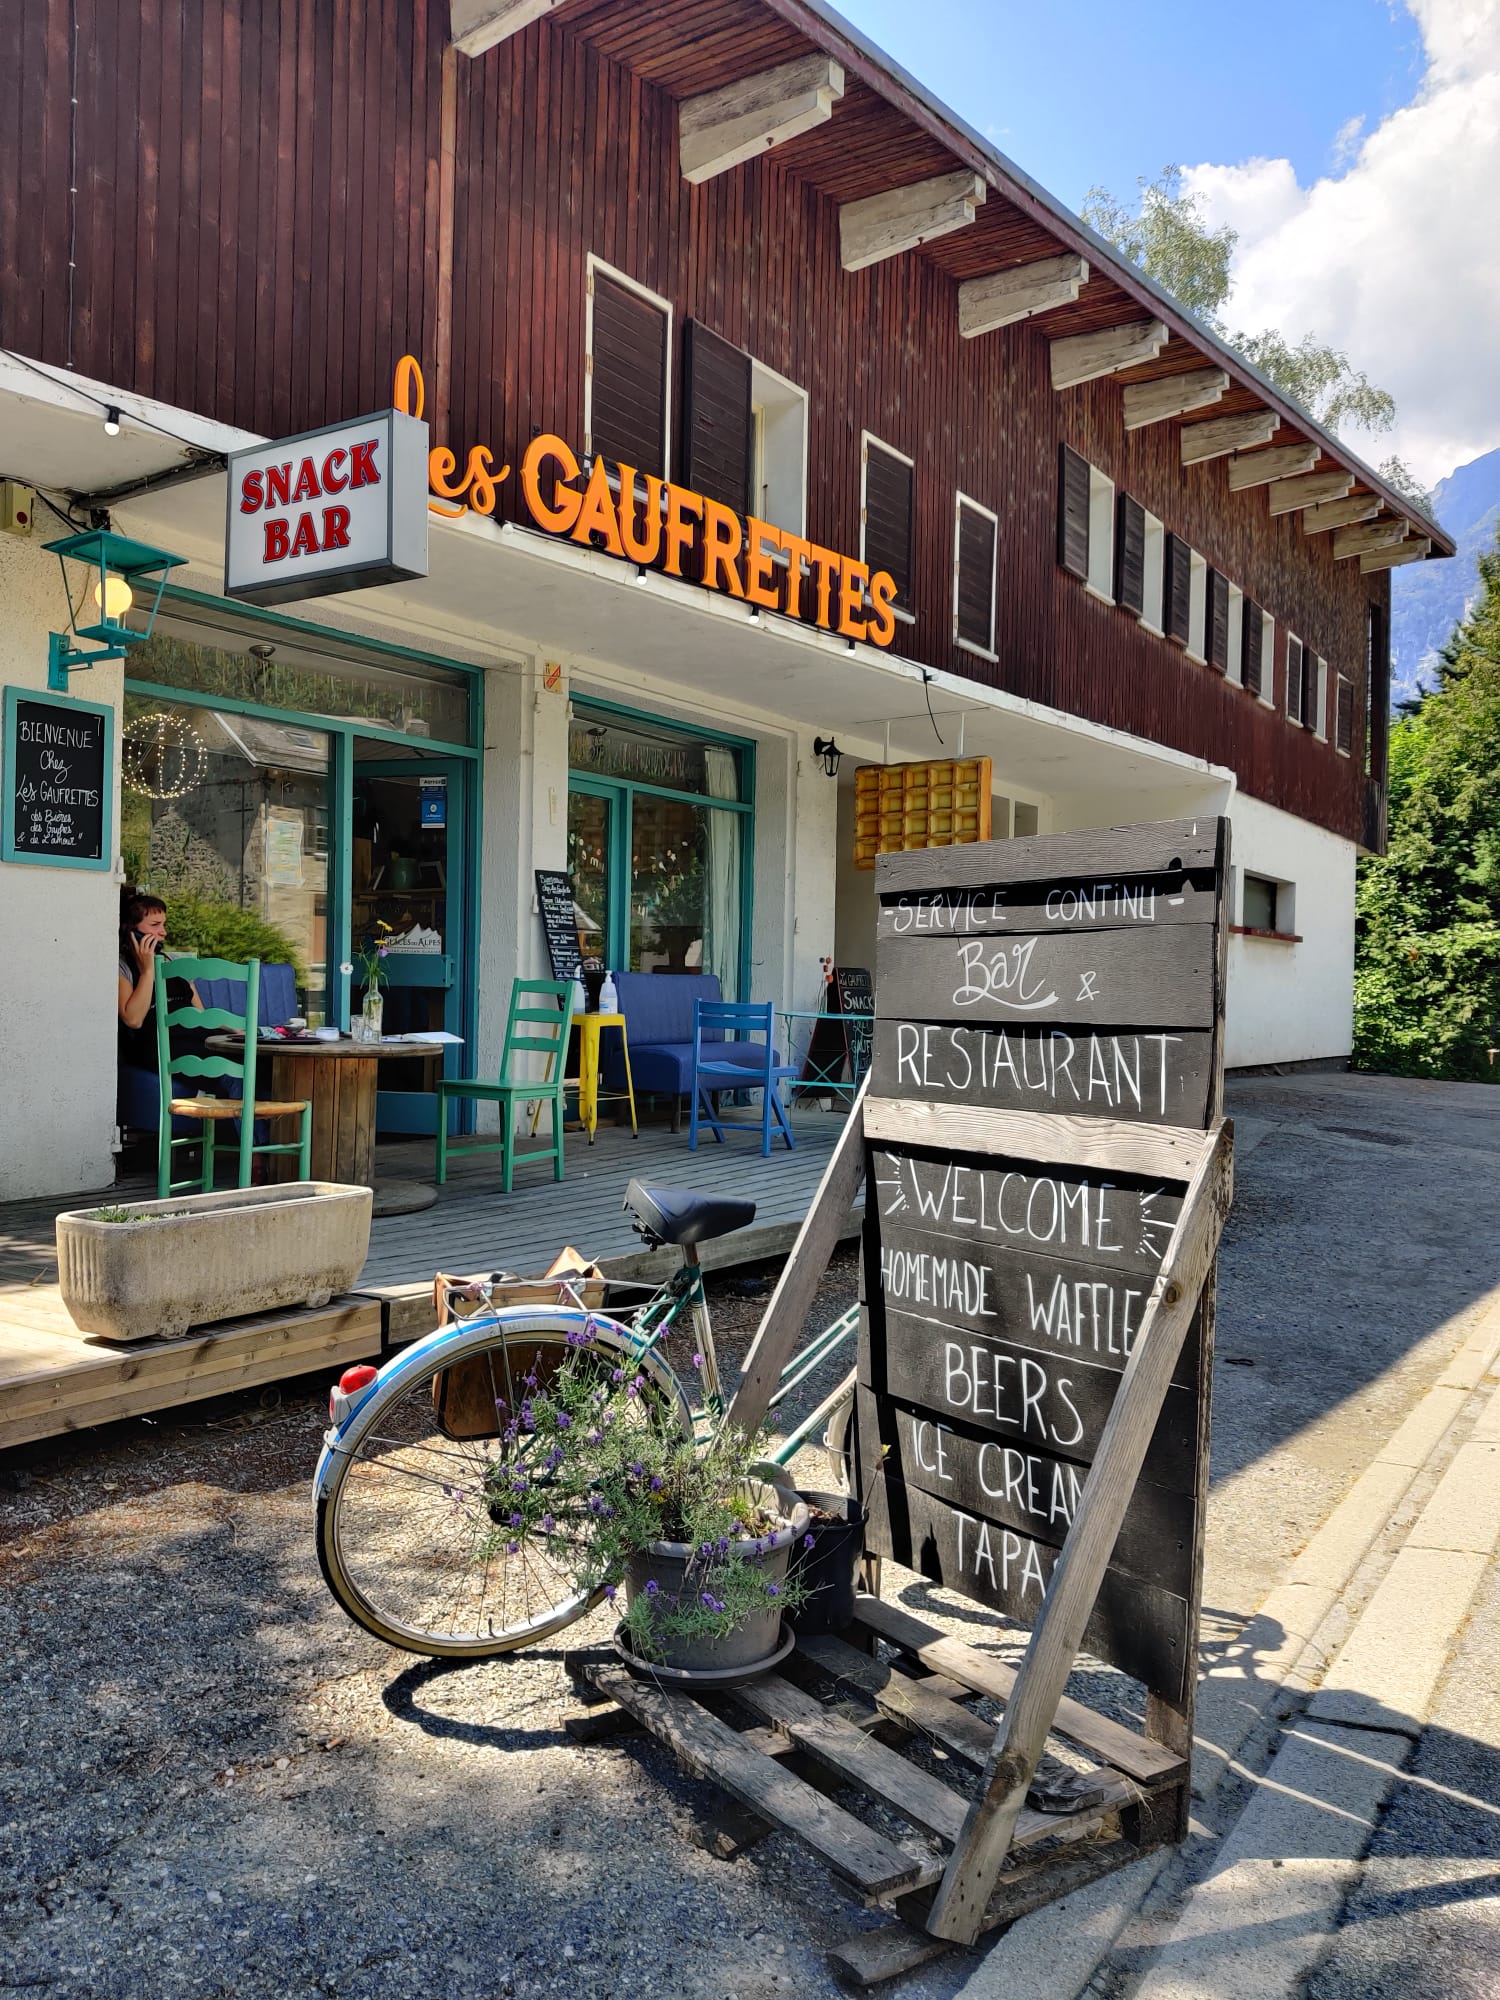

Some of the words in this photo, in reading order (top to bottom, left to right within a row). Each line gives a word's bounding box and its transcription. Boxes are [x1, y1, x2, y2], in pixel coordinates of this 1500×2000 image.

[239, 438, 382, 514] SNACK
[262, 504, 352, 564] BAR
[521, 433, 898, 647] GAUFRETTES
[19, 720, 93, 748] BIENVENUE
[39, 750, 73, 784] Chez
[39, 780, 99, 807] GAUFRETTES
[418, 937, 441, 948] ALPES
[953, 936, 1059, 1010] Bar
[1075, 970, 1100, 1002] &
[897, 1024, 1183, 1116] RESTAURANT
[909, 1158, 1124, 1252] WELCOME
[880, 1246, 998, 1317] HOMEMADE
[945, 1342, 1084, 1446] BEERS
[912, 1419, 954, 1481] ICE
[951, 1509, 1058, 1600] TAPA
